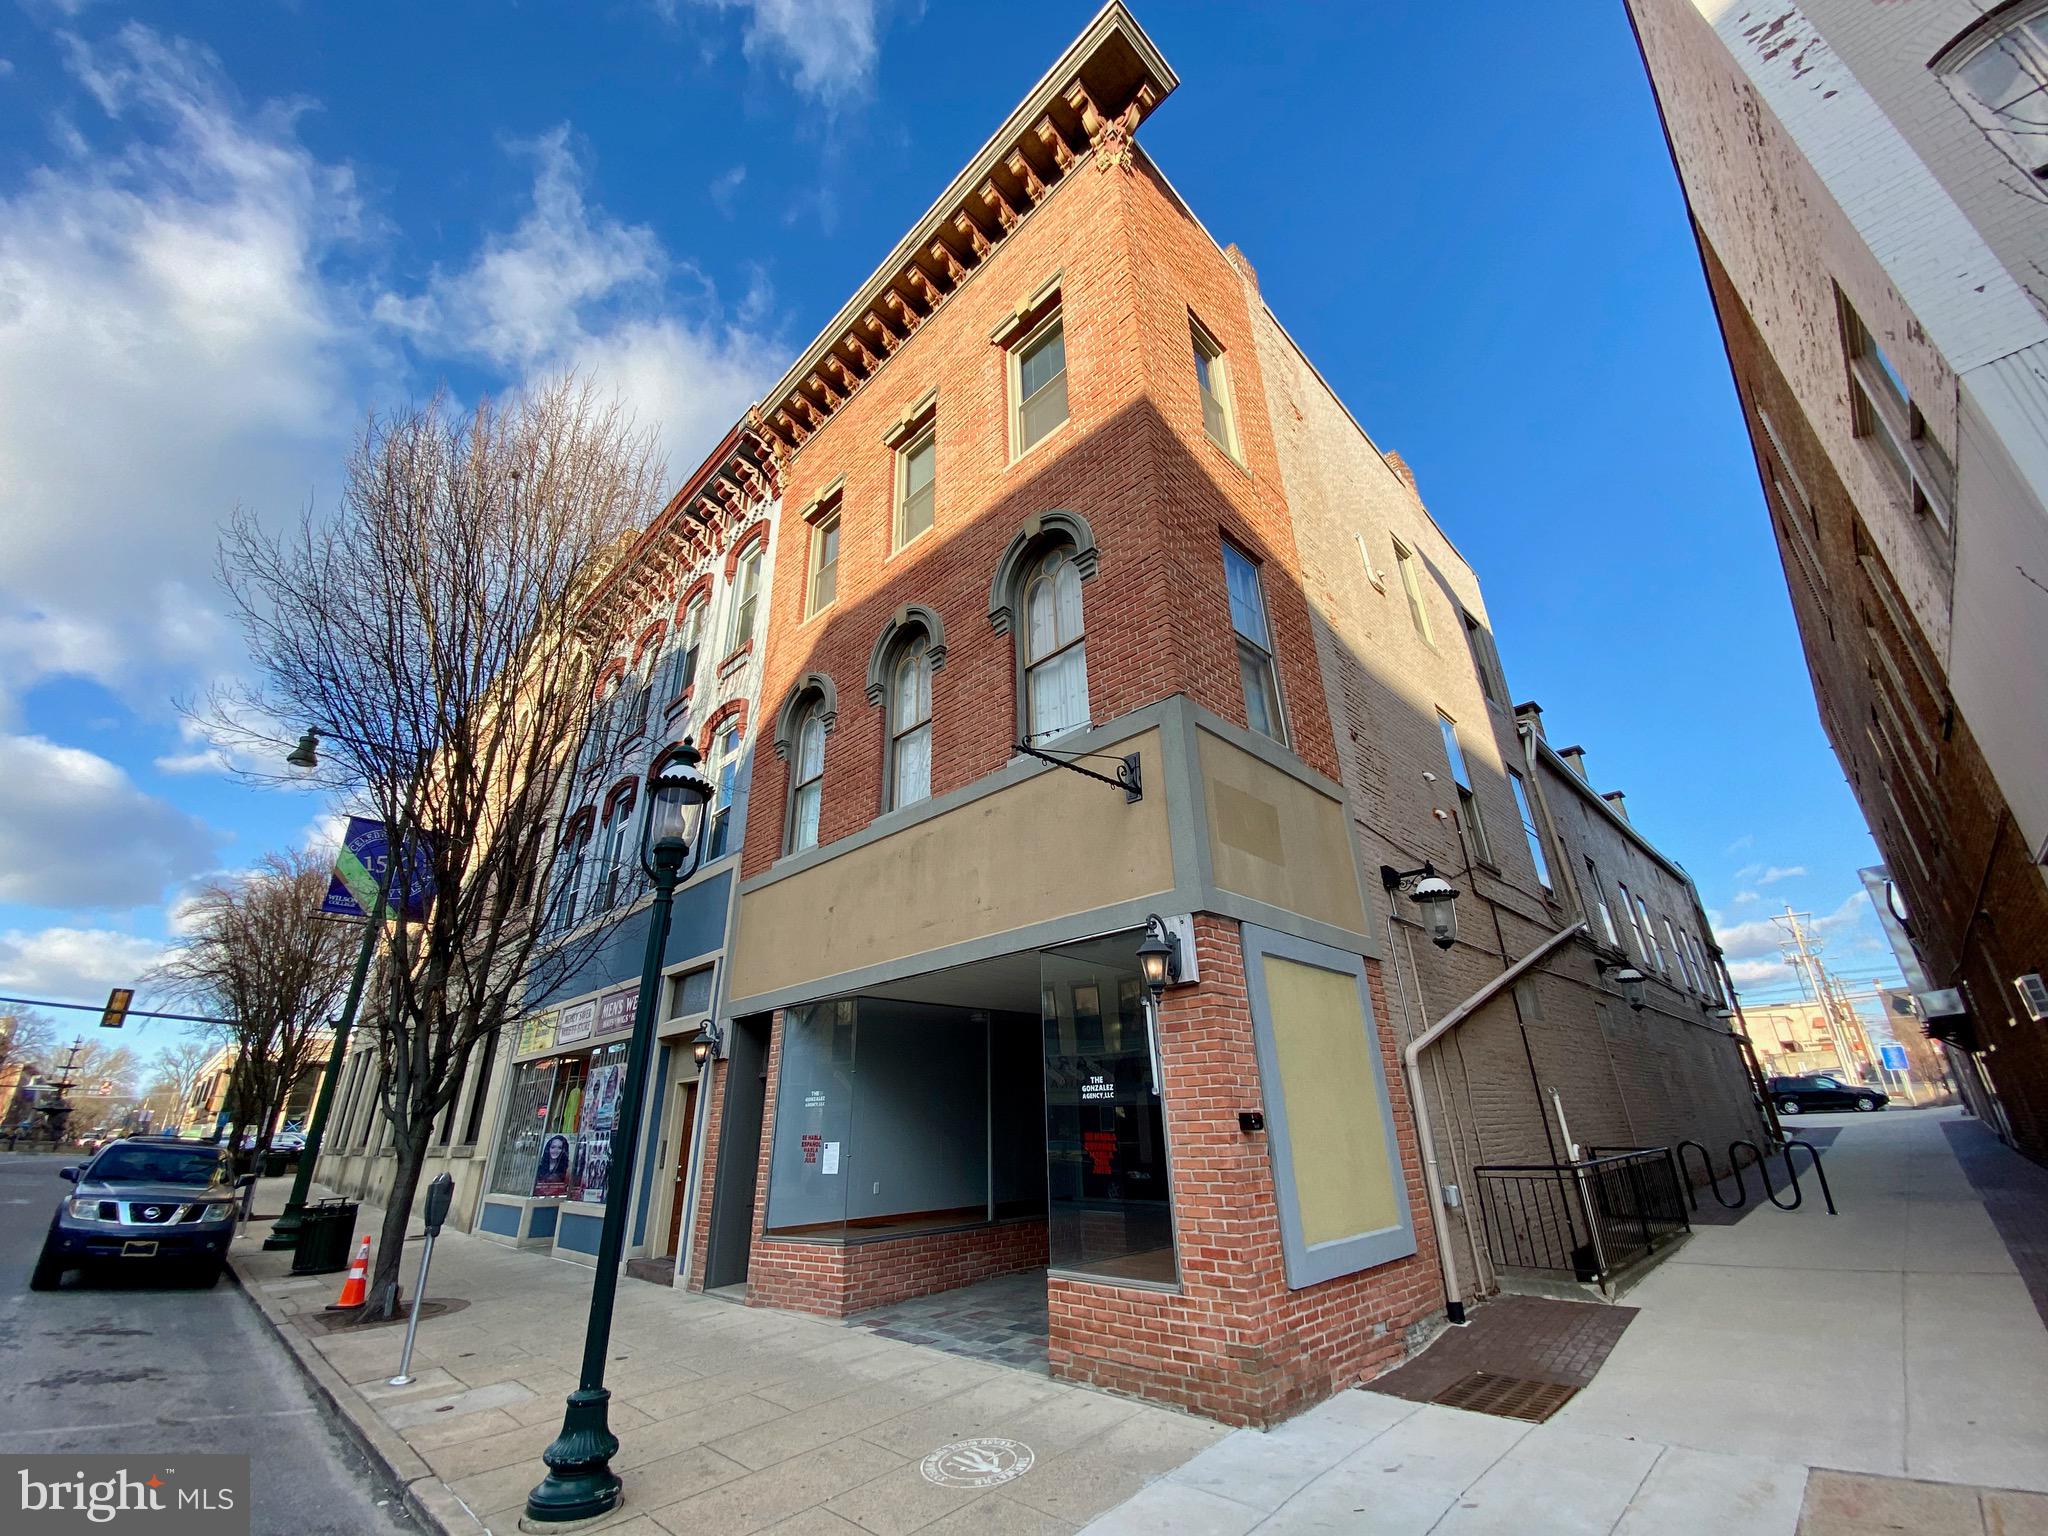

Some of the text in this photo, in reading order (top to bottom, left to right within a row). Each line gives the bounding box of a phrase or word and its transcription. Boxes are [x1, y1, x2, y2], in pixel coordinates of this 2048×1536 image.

[626, 994, 639, 1011] WE
[1090, 1076, 1103, 1084] THE
[1082, 1084, 1114, 1092] GONZALEZ
